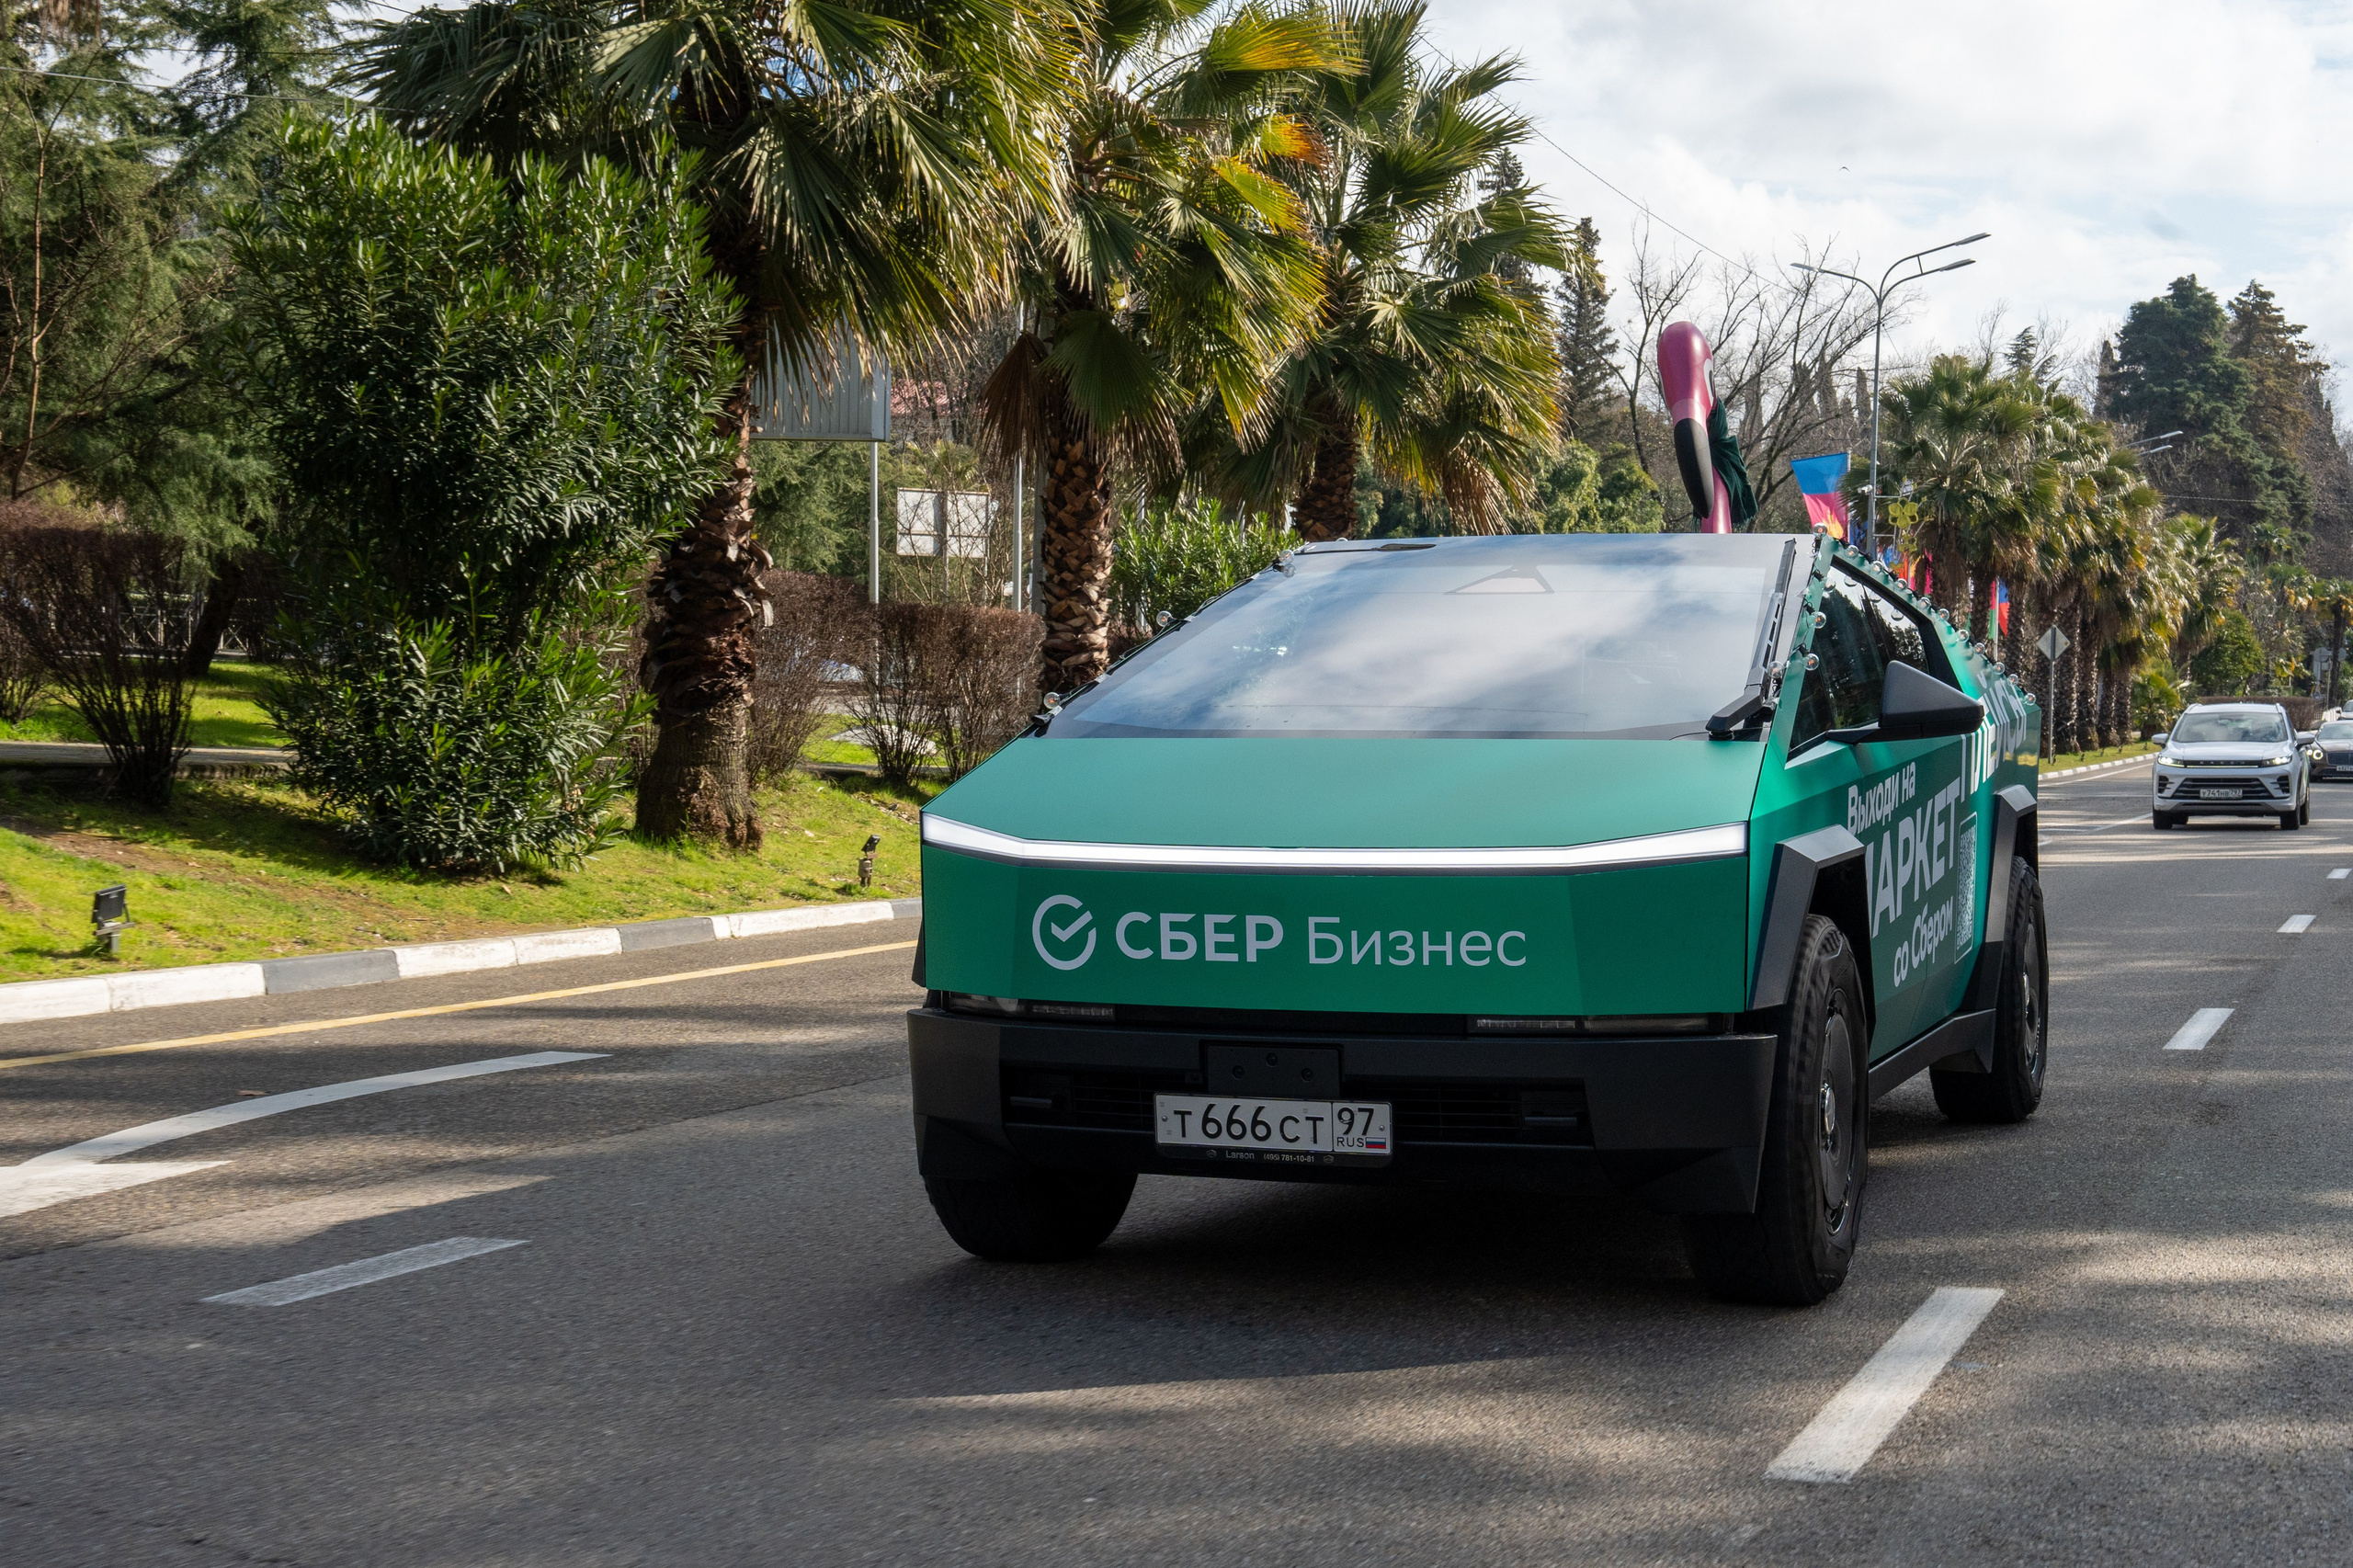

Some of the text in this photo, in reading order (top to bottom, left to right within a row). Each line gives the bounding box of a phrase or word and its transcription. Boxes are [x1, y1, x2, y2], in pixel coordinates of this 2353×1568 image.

[1847, 761, 1915, 835] Выходи на
[1115, 911, 1527, 967] СБЕР Бизнес
[1893, 895, 1953, 988] со Сбером
[1336, 1107, 1375, 1136] 97
[1336, 1136, 1365, 1148] RUS
[1225, 1150, 1256, 1160] Larson
